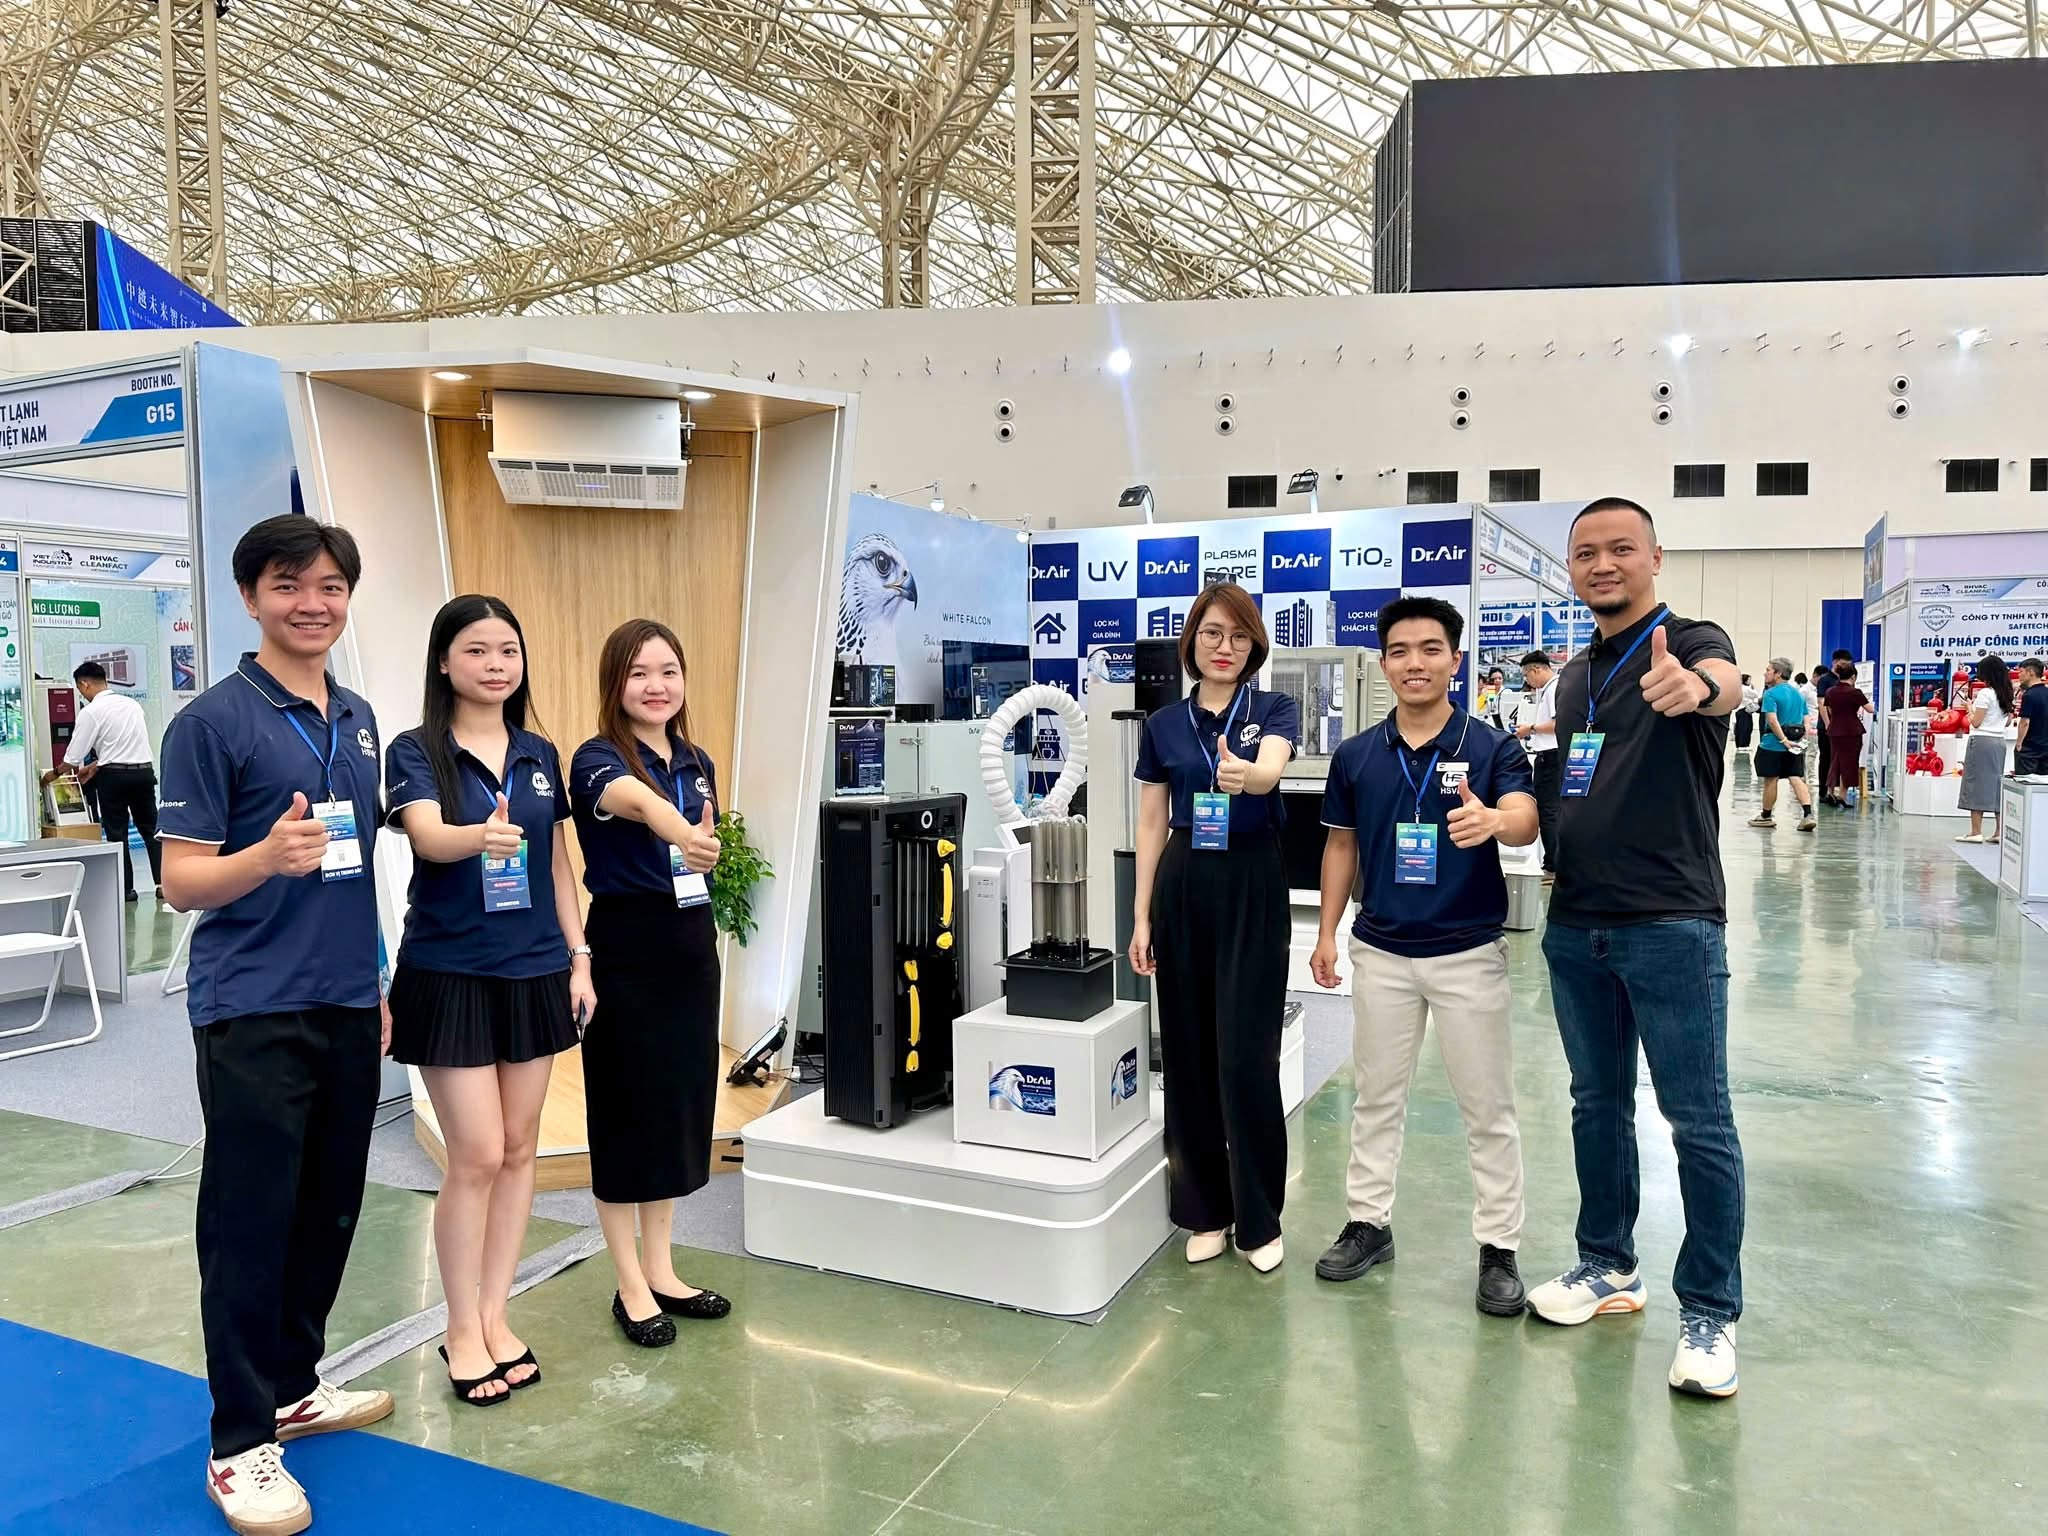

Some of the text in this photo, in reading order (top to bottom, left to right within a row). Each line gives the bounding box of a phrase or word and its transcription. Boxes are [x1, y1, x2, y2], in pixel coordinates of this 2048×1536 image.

[131, 373, 176, 392] BOOTH NO.
[9, 401, 39, 424] LẠNH
[146, 402, 176, 424] G15
[22, 424, 47, 444] NAM
[90, 554, 119, 563] RHVAC
[1204, 548, 1257, 561] PLASMA
[1411, 544, 1467, 563] Dr.Air
[33, 559, 72, 567] INDUSTRY
[80, 560, 129, 570] CLEANFACT
[1144, 559, 1191, 576] Dr.Air
[1271, 552, 1323, 570] Dr.Air
[1088, 560, 1128, 582] UV
[943, 612, 992, 626] WHITE FALCON
[1348, 611, 1364, 620] LỌC
[1961, 613, 1988, 621] CÔNG
[1990, 613, 2000, 621] TY
[1094, 618, 1120, 628] LỌC KHÍ
[1341, 622, 1369, 632] KHÁCH
[1092, 631, 1104, 639] GIA
[1920, 634, 1944, 648] GIẢI
[1948, 634, 1981, 647] PHÁP
[1985, 634, 2019, 646] CÔNG
[1026, 1074, 1052, 1086] Dr.Air
